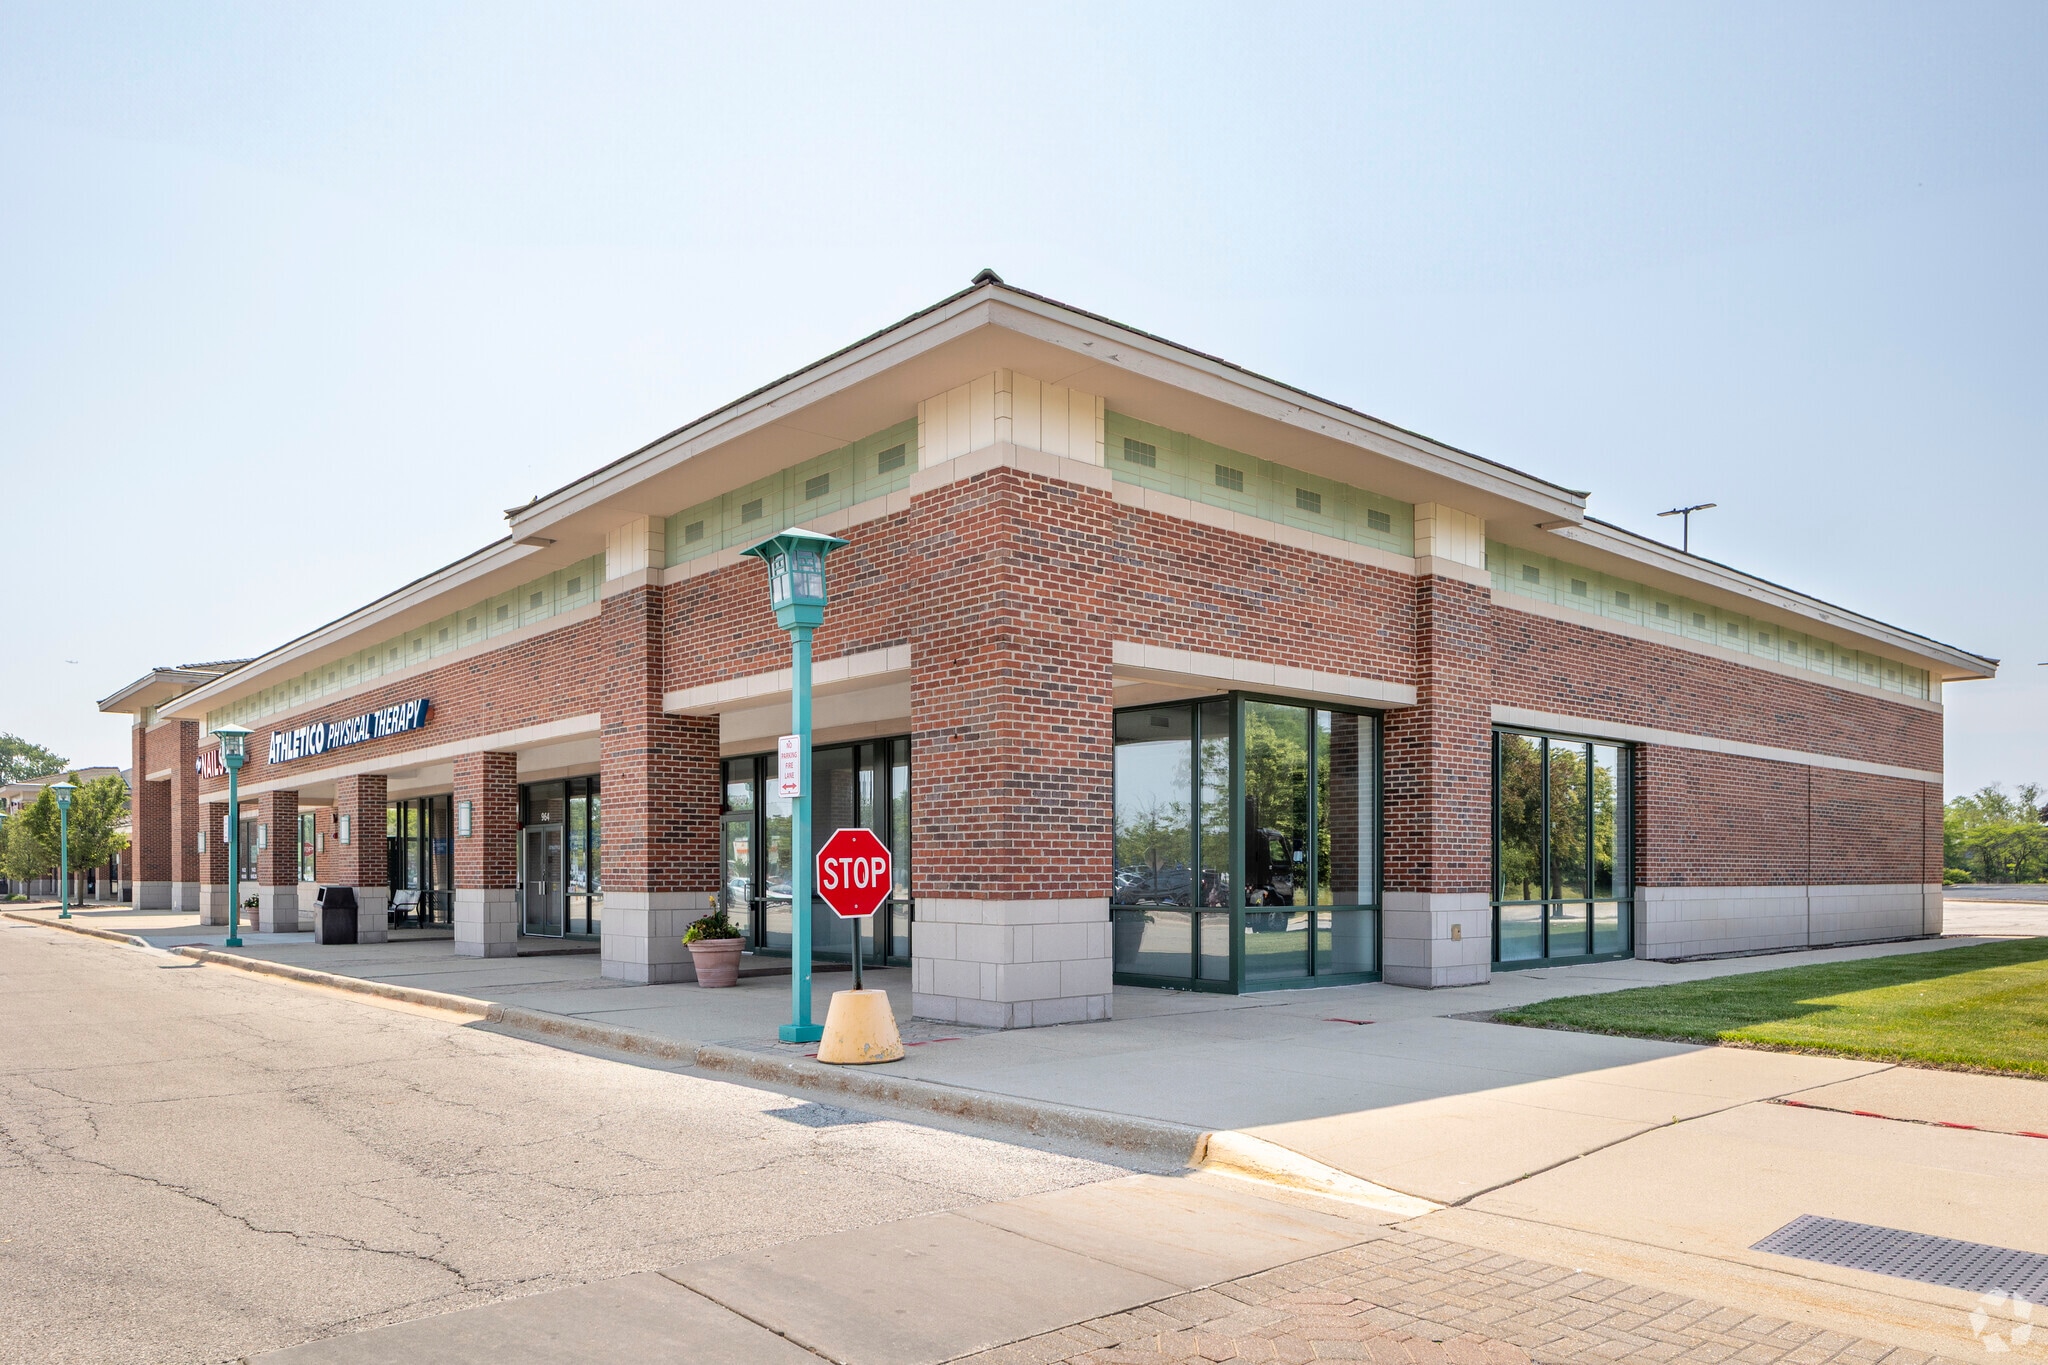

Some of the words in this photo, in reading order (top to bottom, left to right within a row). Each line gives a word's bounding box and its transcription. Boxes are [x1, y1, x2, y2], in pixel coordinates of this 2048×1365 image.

[268, 722, 325, 765] ATHLETICO
[327, 713, 371, 749] PHYSICAL
[374, 698, 422, 738] THERAPY
[201, 748, 224, 779] NAILS
[823, 857, 886, 890] STOP
